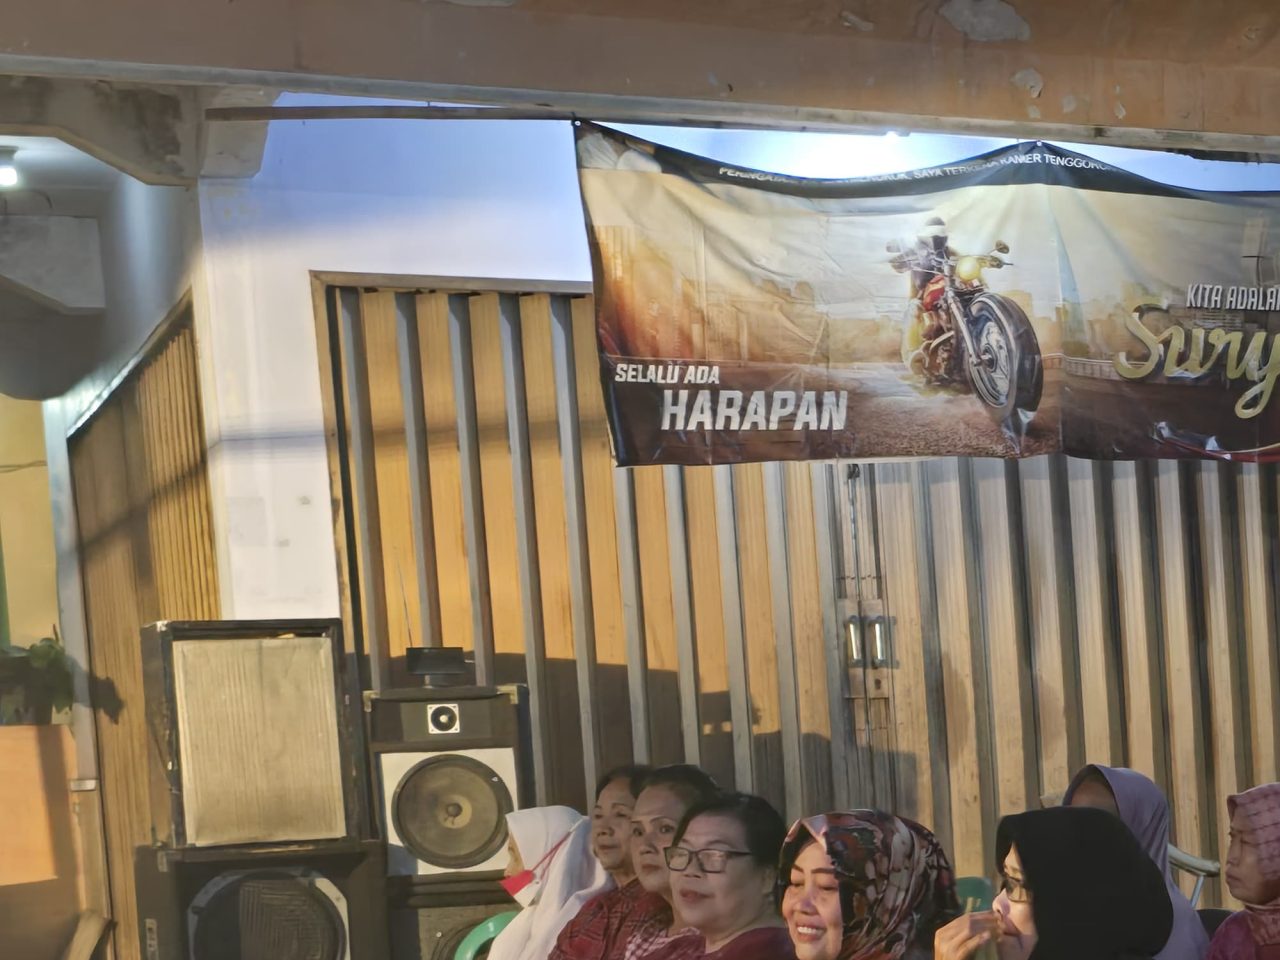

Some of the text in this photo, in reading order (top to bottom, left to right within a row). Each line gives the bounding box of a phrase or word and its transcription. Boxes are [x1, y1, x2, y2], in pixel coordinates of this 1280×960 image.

[913, 167, 944, 180] SAYA
[1186, 283, 1222, 309] KITA
[615, 363, 720, 385] SELALU ADA
[661, 389, 848, 431] HARAPAN
